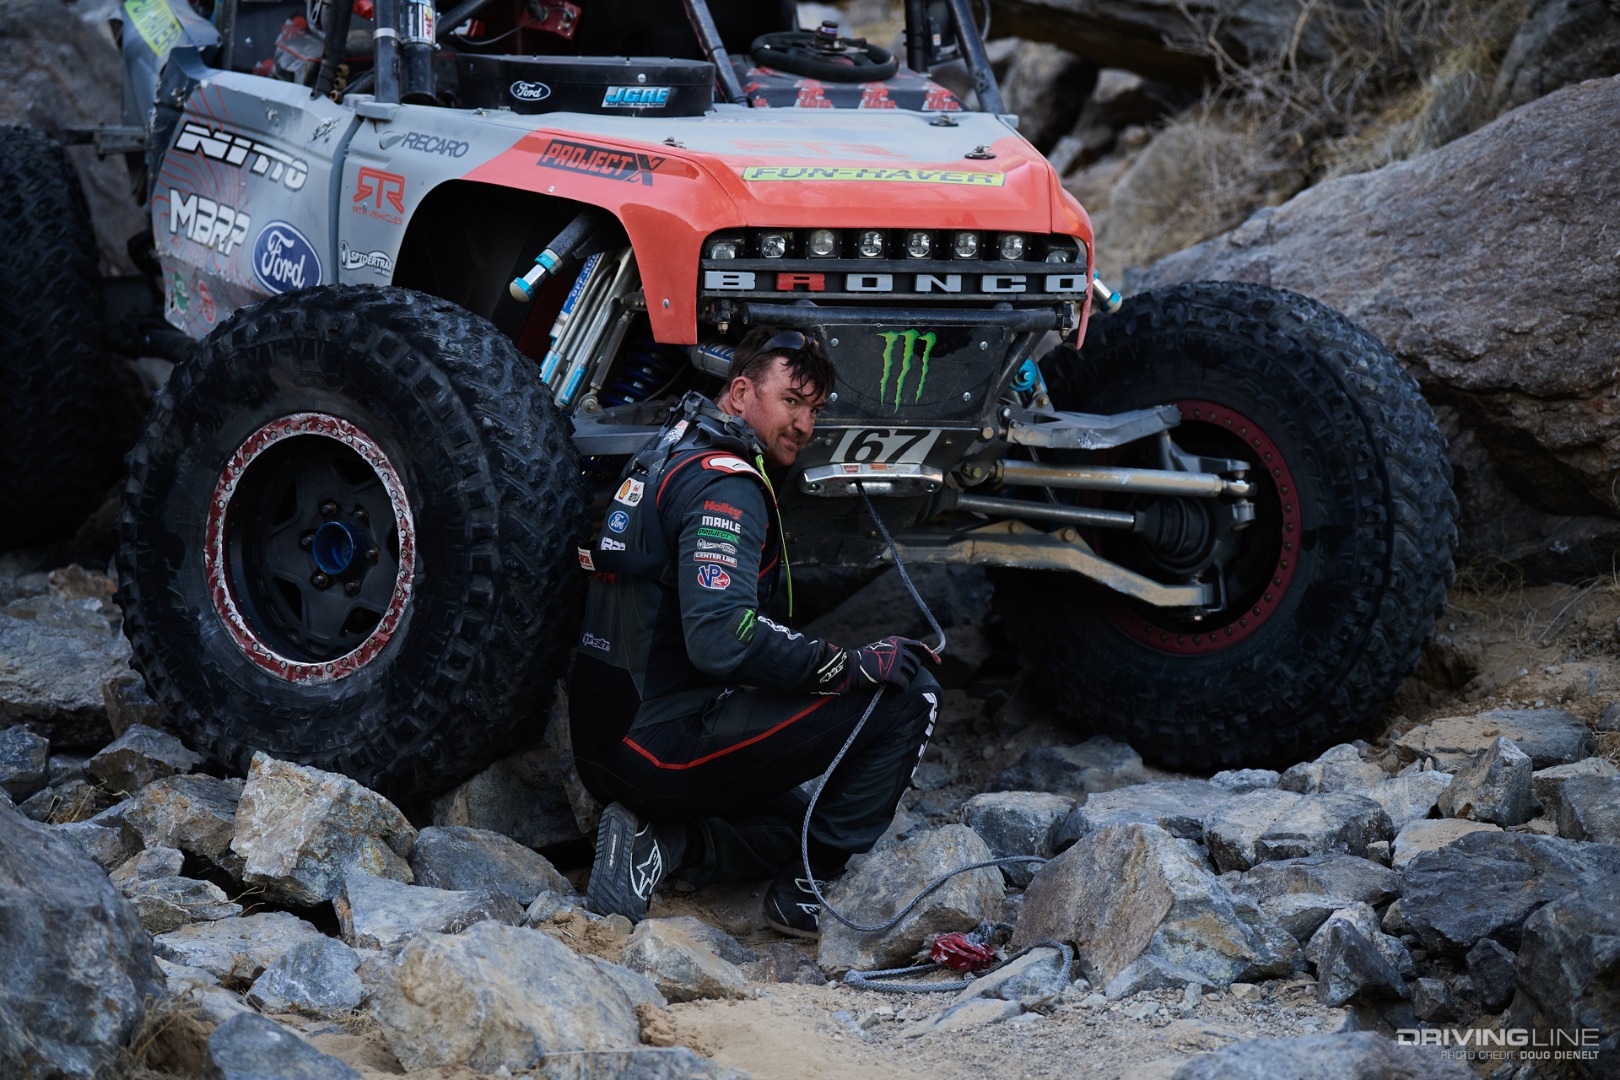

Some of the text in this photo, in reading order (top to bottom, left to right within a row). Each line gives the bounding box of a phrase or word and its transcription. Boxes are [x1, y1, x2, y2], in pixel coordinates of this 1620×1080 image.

[517, 81, 542, 98] Ford
[605, 87, 669, 103] JGRE
[402, 132, 469, 158] RECARO
[174, 122, 309, 191] NITTO
[750, 167, 995, 185] FUN-HAVER
[353, 166, 405, 214] RTR
[169, 188, 250, 256] MBRP
[368, 209, 403, 225] VEHICLES
[261, 230, 306, 288] Ford
[704, 270, 1087, 294] BRONCO
[843, 429, 931, 463] 67
[703, 500, 742, 519] Holley
[610, 513, 625, 531] Ford
[702, 515, 741, 533] MAHLE
[695, 552, 721, 561] CENTER
[699, 564, 722, 589] VP
